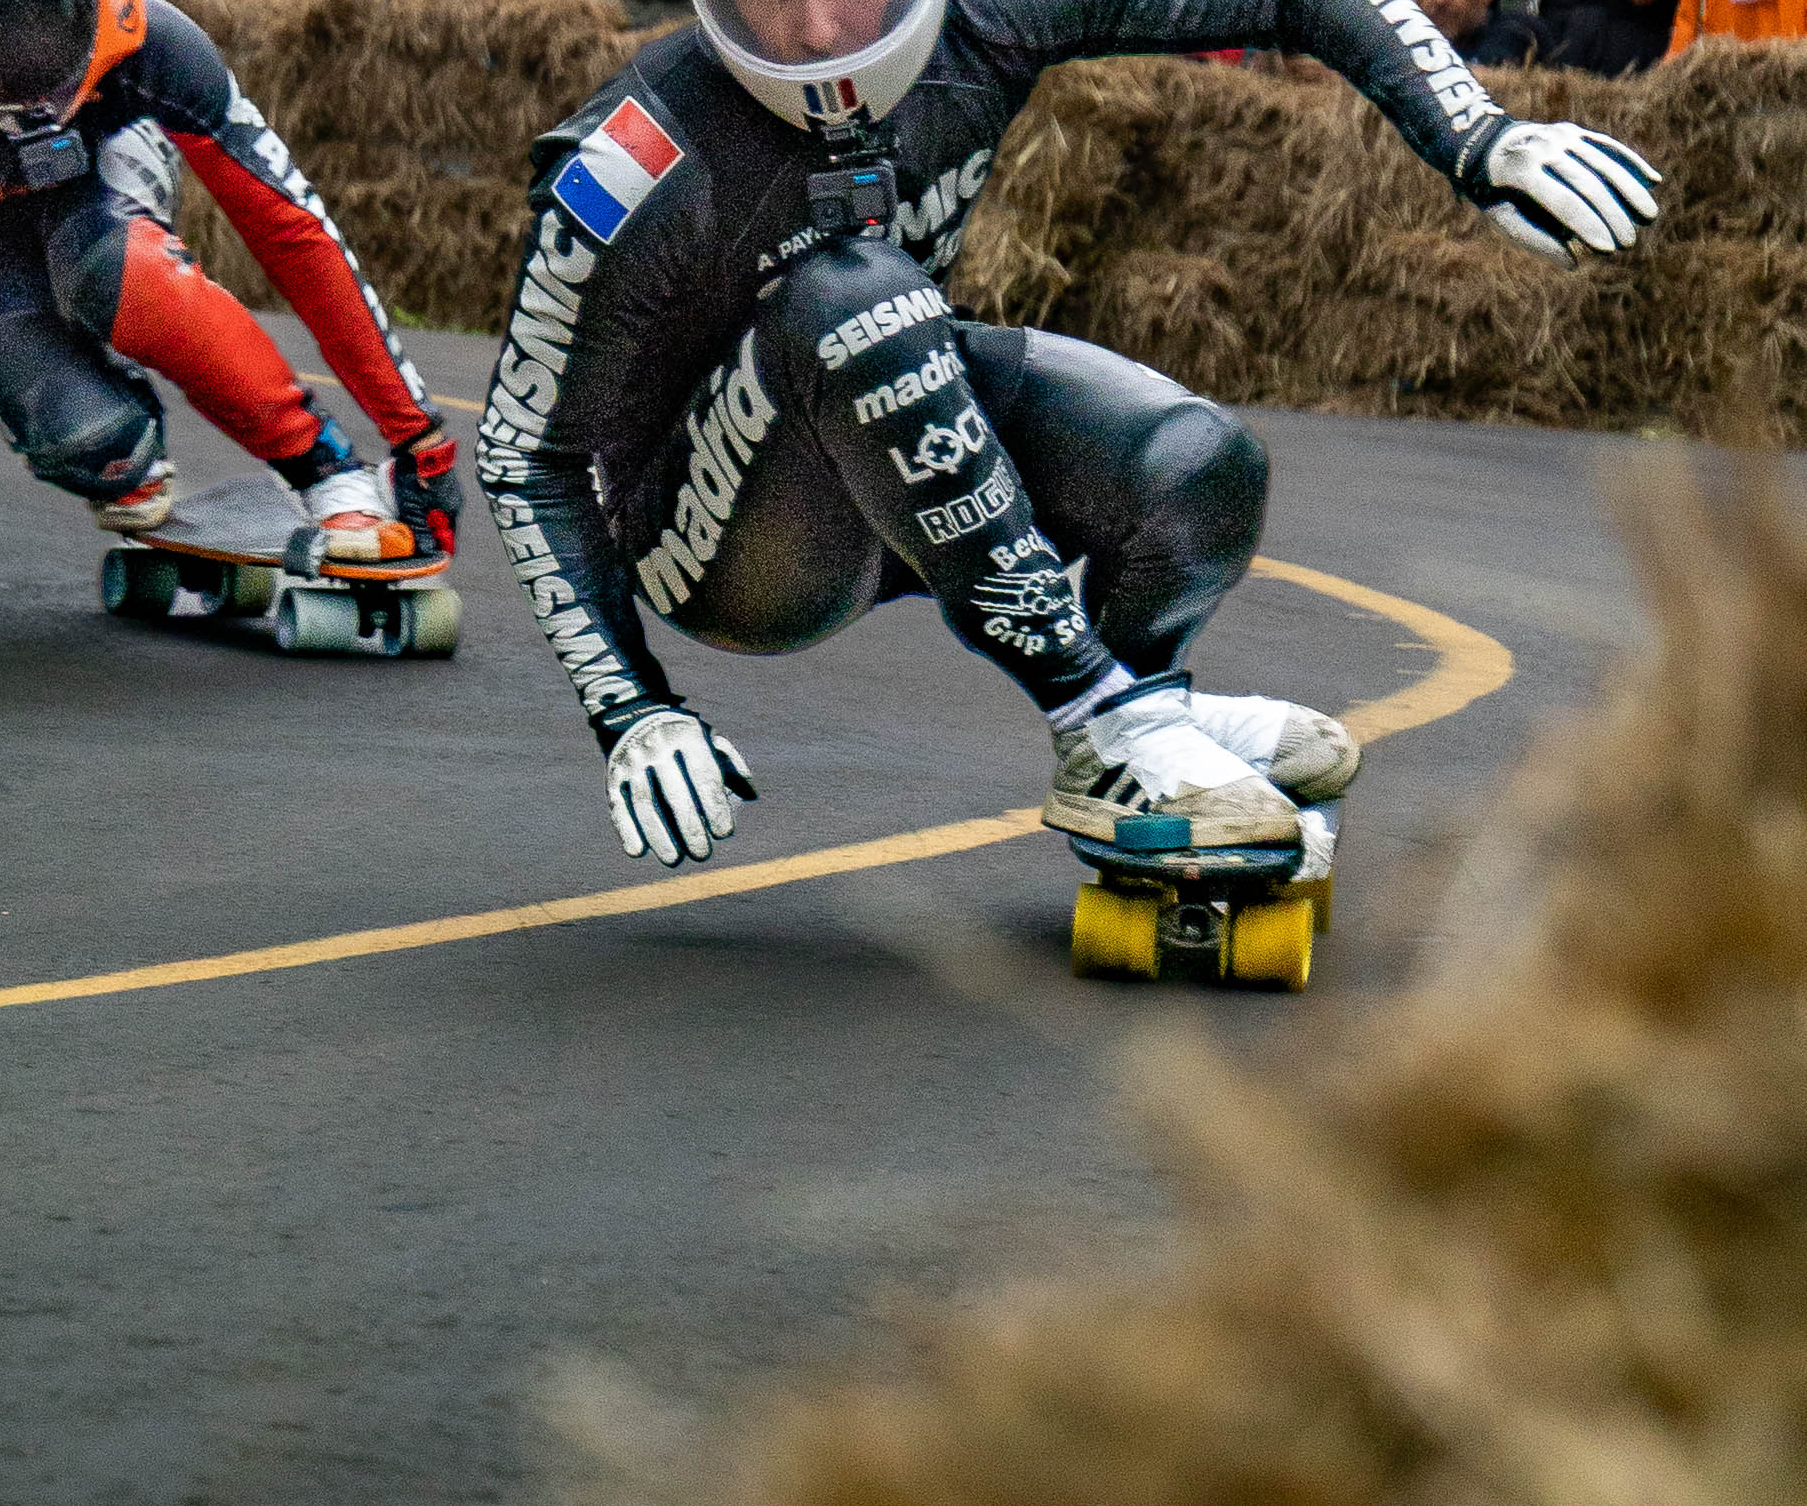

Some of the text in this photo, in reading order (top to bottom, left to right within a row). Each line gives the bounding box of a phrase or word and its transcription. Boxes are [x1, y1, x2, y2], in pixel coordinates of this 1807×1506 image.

[778, 226, 830, 260] PAY
[475, 208, 596, 485] SEISMIC
[818, 287, 952, 381] SEISMI
[853, 342, 966, 424] madri
[636, 327, 778, 615] madrid
[888, 398, 990, 485] LOC
[916, 456, 1016, 544] ROG
[485, 491, 639, 716] SEISMIC
[983, 616, 1046, 656] Grip
